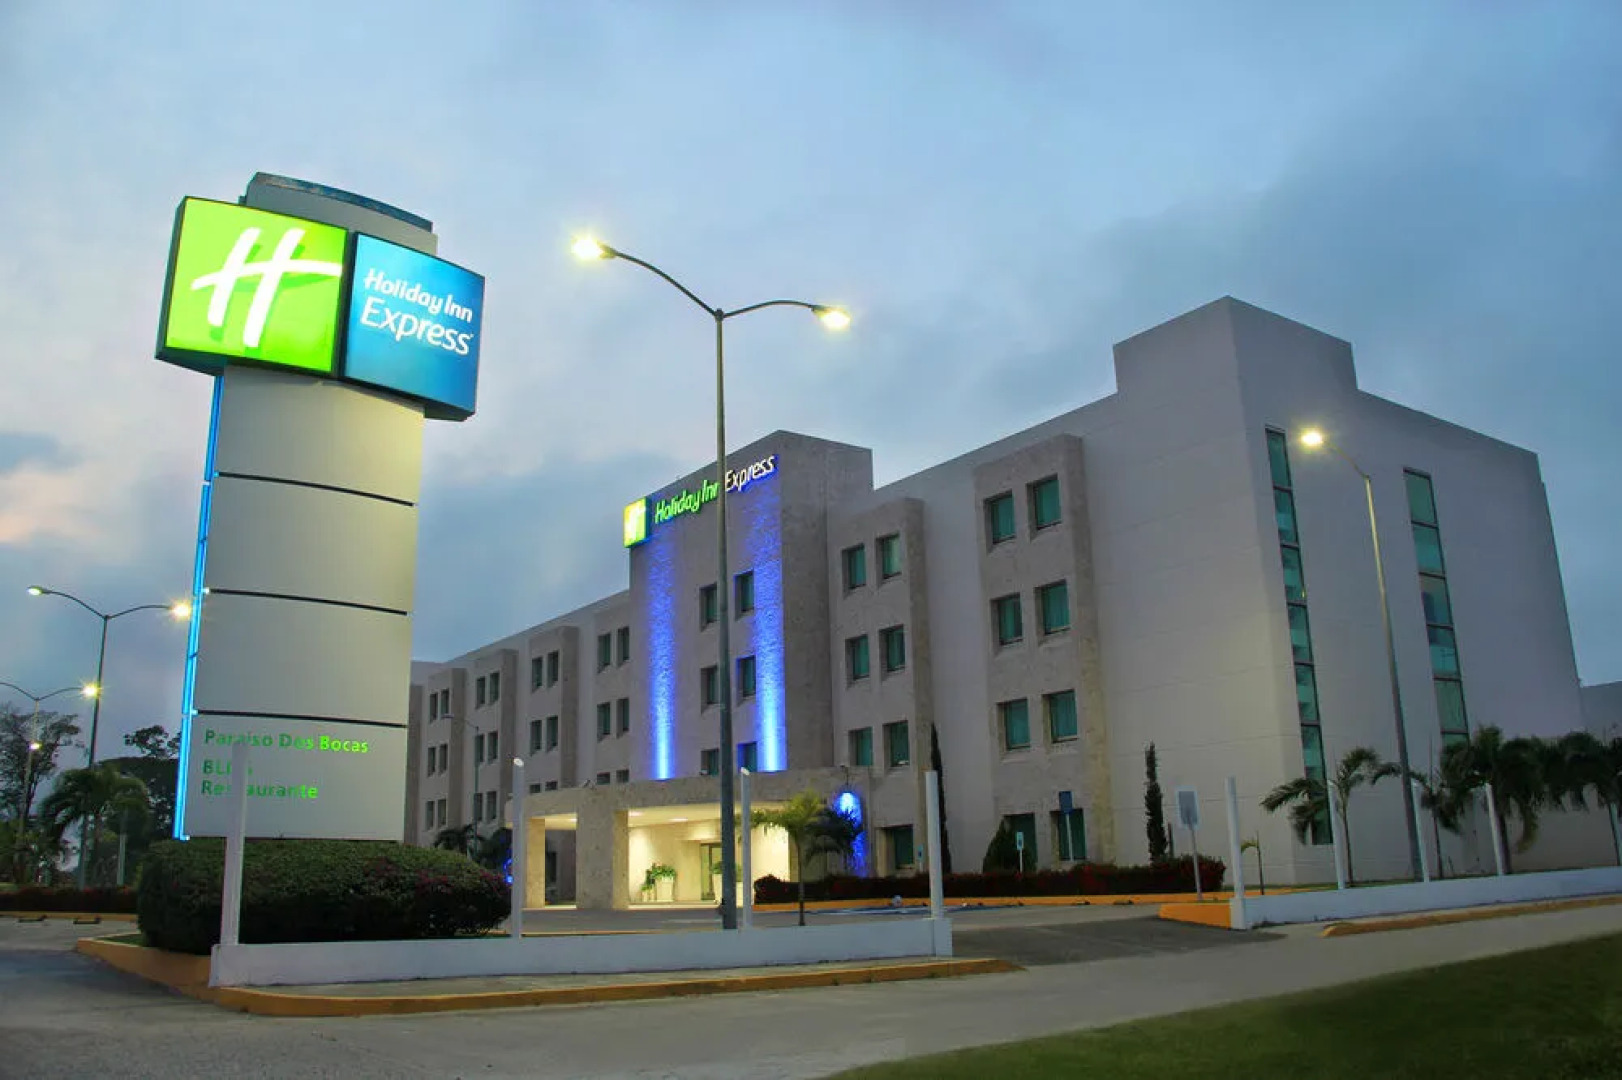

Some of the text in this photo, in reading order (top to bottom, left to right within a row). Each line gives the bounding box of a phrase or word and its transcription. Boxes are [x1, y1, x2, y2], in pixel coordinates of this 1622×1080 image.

[363, 268, 473, 324] Holiday Inn
[360, 296, 471, 355] Express
[654, 490, 701, 525] Holiday
[725, 455, 775, 492] Express
[278, 733, 314, 750] Dos
[319, 735, 369, 753] Bocas
[202, 759, 254, 776] BLI
[201, 779, 319, 799] Reaurante
